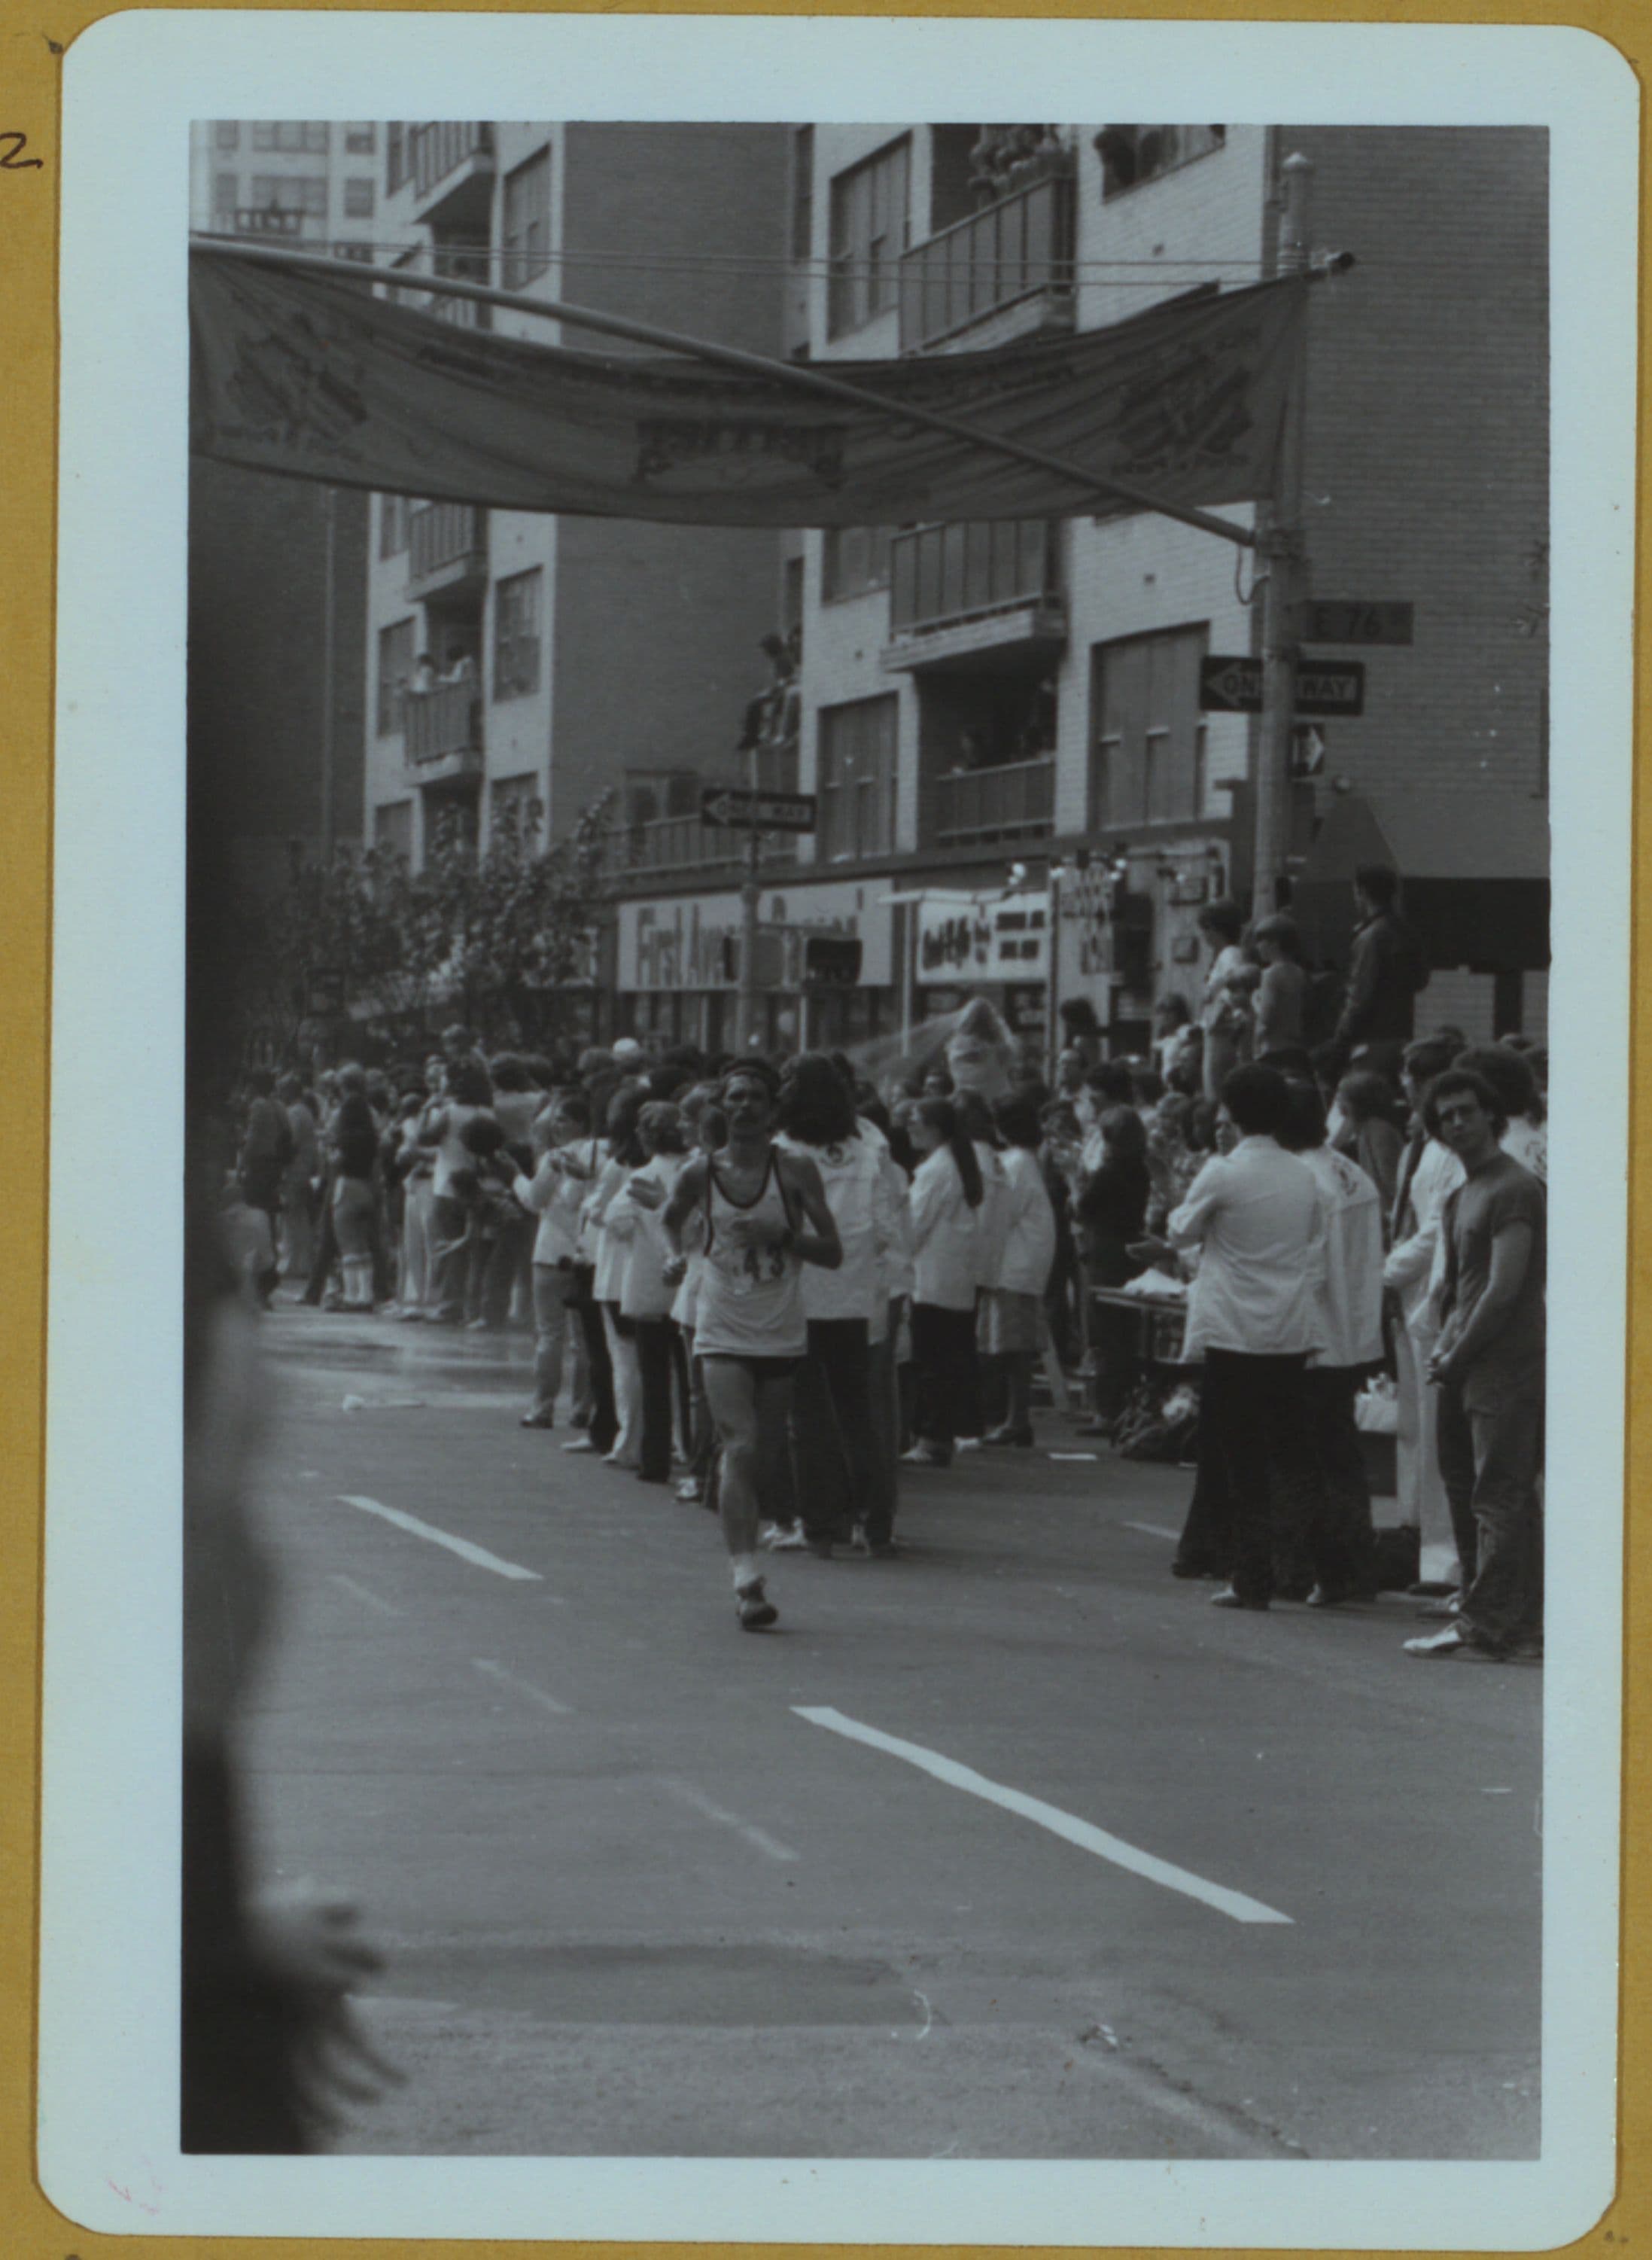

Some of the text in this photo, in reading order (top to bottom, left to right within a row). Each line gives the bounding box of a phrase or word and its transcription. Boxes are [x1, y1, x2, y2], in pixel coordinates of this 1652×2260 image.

[1314, 606, 1331, 638] E
[1344, 604, 1383, 638] 76
[1223, 673, 1352, 701] ON WAY
